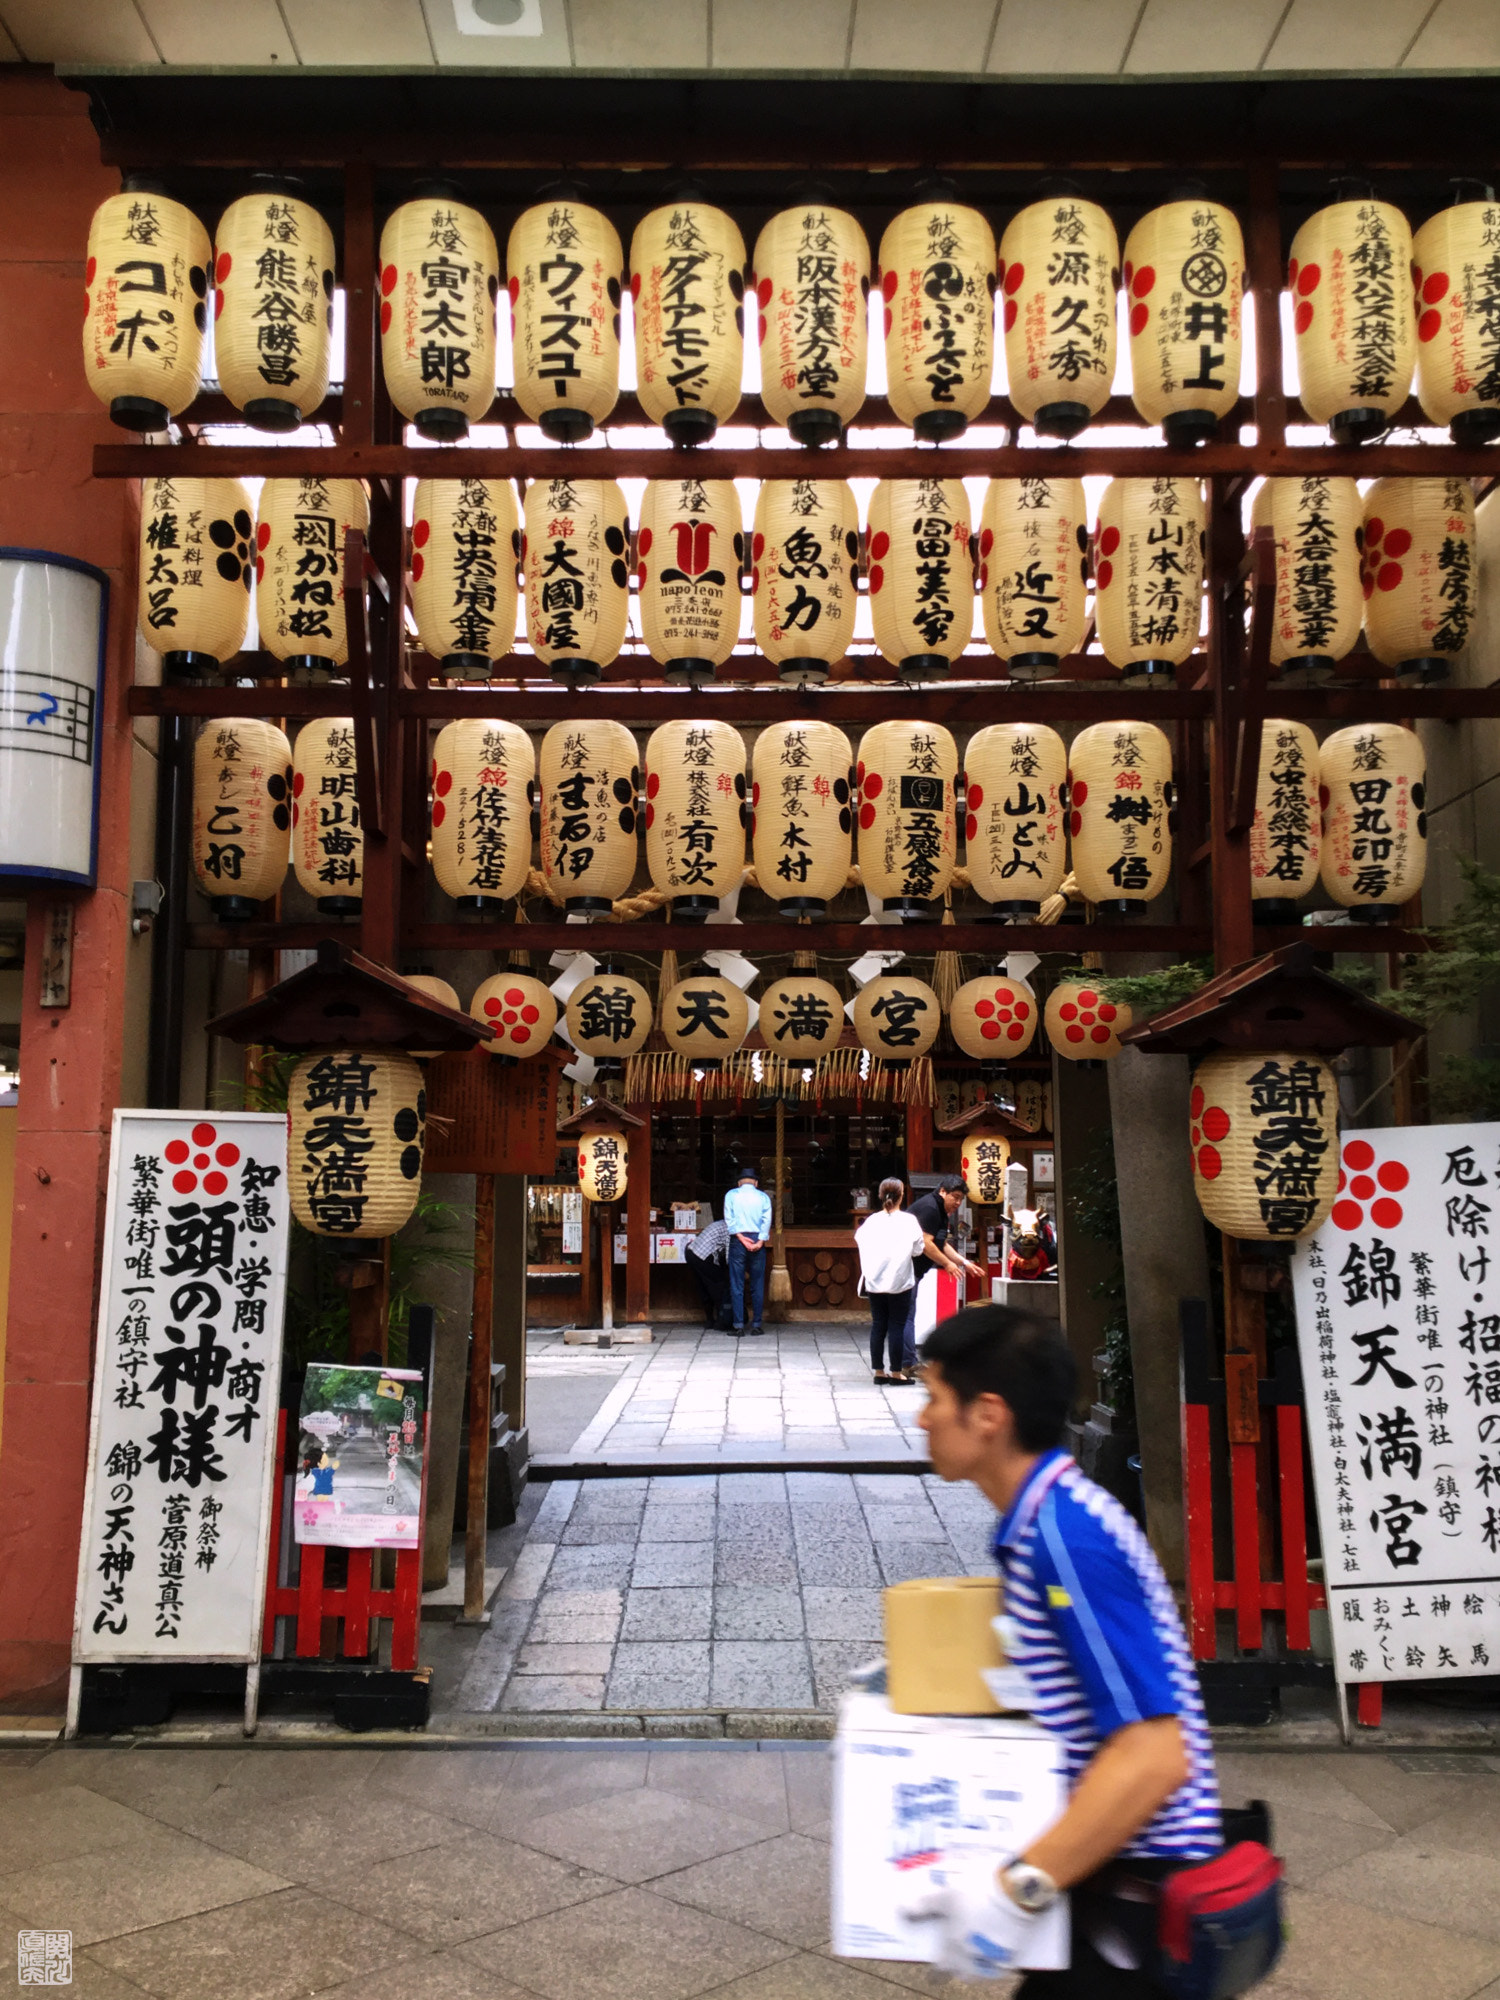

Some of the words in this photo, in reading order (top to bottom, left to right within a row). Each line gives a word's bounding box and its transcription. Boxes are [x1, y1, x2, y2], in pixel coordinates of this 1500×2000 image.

[109, 259, 176, 361] コポ
[252, 247, 302, 386] 熊谷勝昌
[420, 256, 471, 388] 寅太郎
[538, 253, 592, 397] ウィズユー
[661, 250, 712, 406] ダイアモンド
[796, 254, 842, 400] 阪本漢方堂
[1047, 252, 1092, 382] 源久秀
[1182, 301, 1228, 391] 井上
[1349, 242, 1397, 398] 積水ハウス株式会社
[422, 387, 469, 402] TORATARO
[146, 511, 181, 630] 権太呂
[181, 510, 205, 587] そば料理
[452, 508, 497, 536] 京都
[547, 516, 576, 539] 錦
[290, 548, 339, 639] かね松
[542, 540, 585, 650] 大國屋
[660, 584, 723, 599] napoleon
[778, 525, 829, 632] 魚力
[1011, 561, 1061, 639] 近又
[1141, 518, 1188, 646] 山本清掃
[1293, 512, 1339, 649] 大岩建設工業
[476, 766, 508, 788] 錦
[686, 770, 712, 816] 株式会社
[1114, 771, 1143, 791] 錦
[1266, 769, 1311, 881] 中徳総本店
[204, 805, 246, 881] 乙羽
[318, 773, 363, 887] 明山歯科
[467, 785, 510, 890] 佐竹生花店
[678, 820, 719, 886] 有次
[776, 822, 814, 883] 木村
[1001, 782, 1046, 880] 山とみ
[1350, 778, 1394, 898] 田丸印房
[576, 986, 636, 1043] 錦
[676, 990, 730, 1039] 天
[774, 993, 833, 1042] 満
[871, 990, 927, 1046] 宮
[302, 1054, 378, 1233] 錦天満宮
[592, 1138, 619, 1200] 錦天満宮
[976, 1142, 1001, 1201] 錦天満宮
[1246, 1061, 1328, 1235] 錦天満宮
[113, 1154, 164, 1410] 繁華街唯一の鎮守社
[223, 1157, 281, 1442] 知恵・学問・商才
[144, 1201, 239, 1488] 頭の神様
[1338, 1238, 1428, 1569] 錦天満宮
[93, 1440, 142, 1636] 錦の天神さん
[155, 1493, 192, 1638] 菅原道真公
[194, 1495, 224, 1574] 御祭神
[1343, 1599, 1368, 1672] 腹帯
[1373, 1598, 1395, 1671] おみくじ
[1402, 1597, 1425, 1668] 土鈴
[1431, 1595, 1458, 1667] 神矢
[1463, 1594, 1490, 1667] 絵馬
